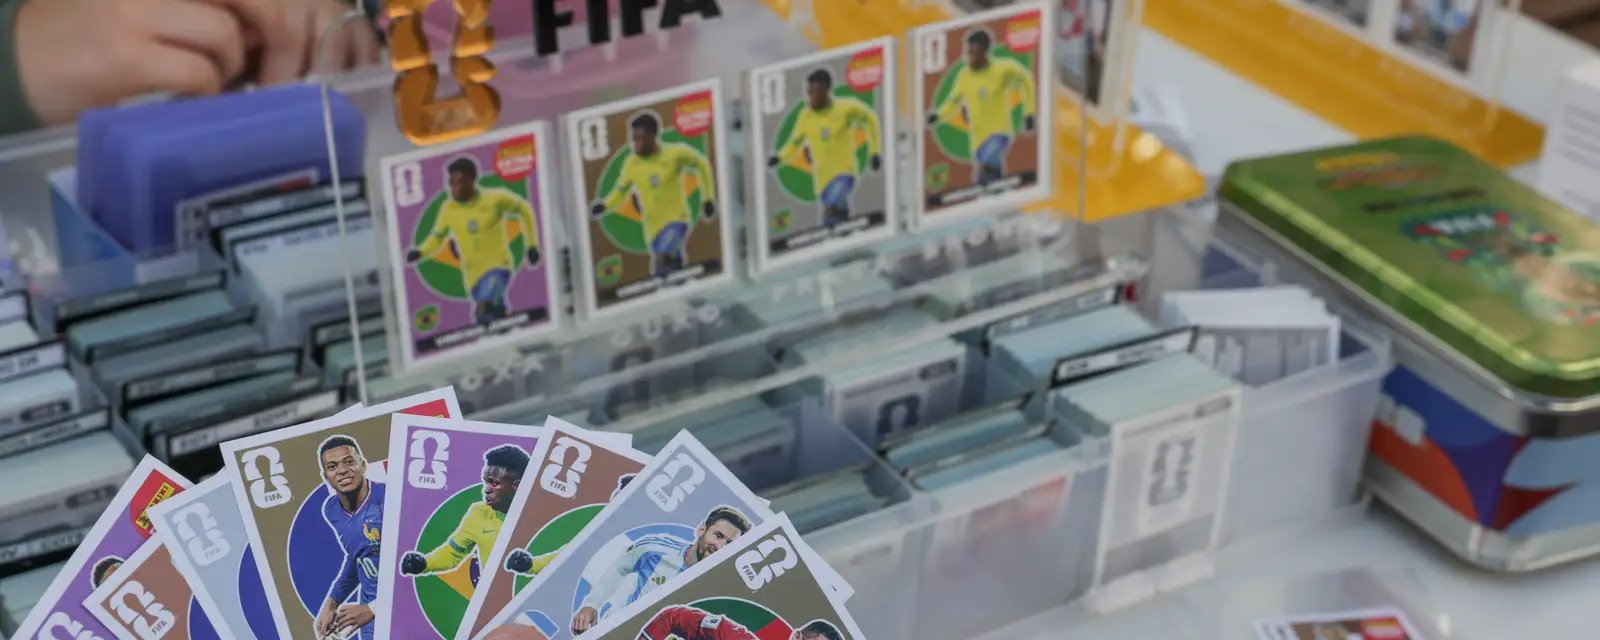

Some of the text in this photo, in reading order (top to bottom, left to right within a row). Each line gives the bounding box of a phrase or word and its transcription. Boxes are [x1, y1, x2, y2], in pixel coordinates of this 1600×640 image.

[418, 475, 436, 485] FIFA
[549, 480, 567, 493] FIFA
[264, 492, 283, 503] FIFA
[652, 490, 669, 506] FIFA
[356, 557, 379, 580] 10
[741, 565, 755, 582] FIFA
[151, 620, 168, 635] FIFA
